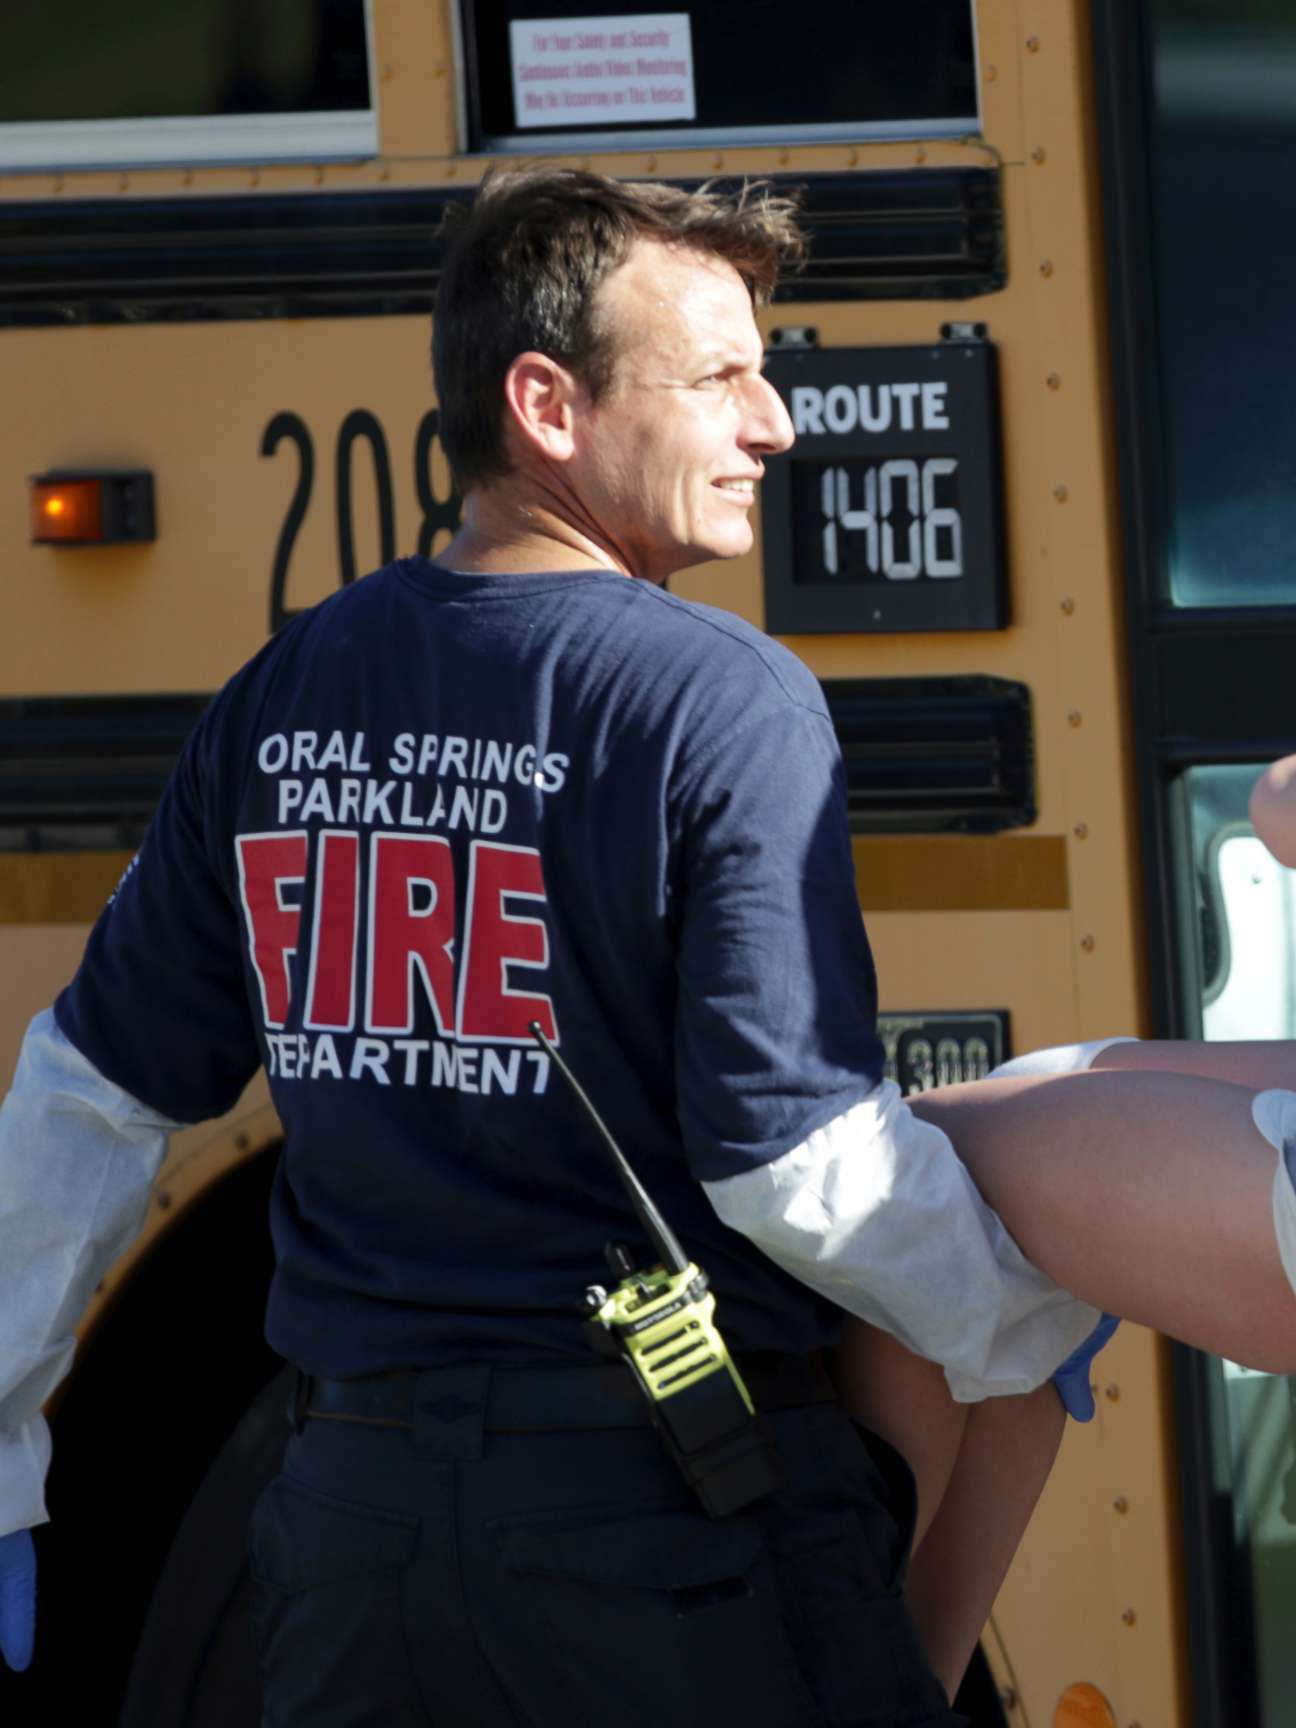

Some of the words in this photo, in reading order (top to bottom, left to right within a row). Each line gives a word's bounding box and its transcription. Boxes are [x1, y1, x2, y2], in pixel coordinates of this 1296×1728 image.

[630, 30, 670, 49] Security
[636, 58, 687, 78] Monitoring
[791, 381, 950, 434] ROUTE
[821, 457, 964, 580] 1406
[257, 730, 371, 774] ORAL
[389, 733, 570, 793] SPRINGS
[277, 778, 508, 834] PARKLAND
[235, 829, 560, 1047] FIRE
